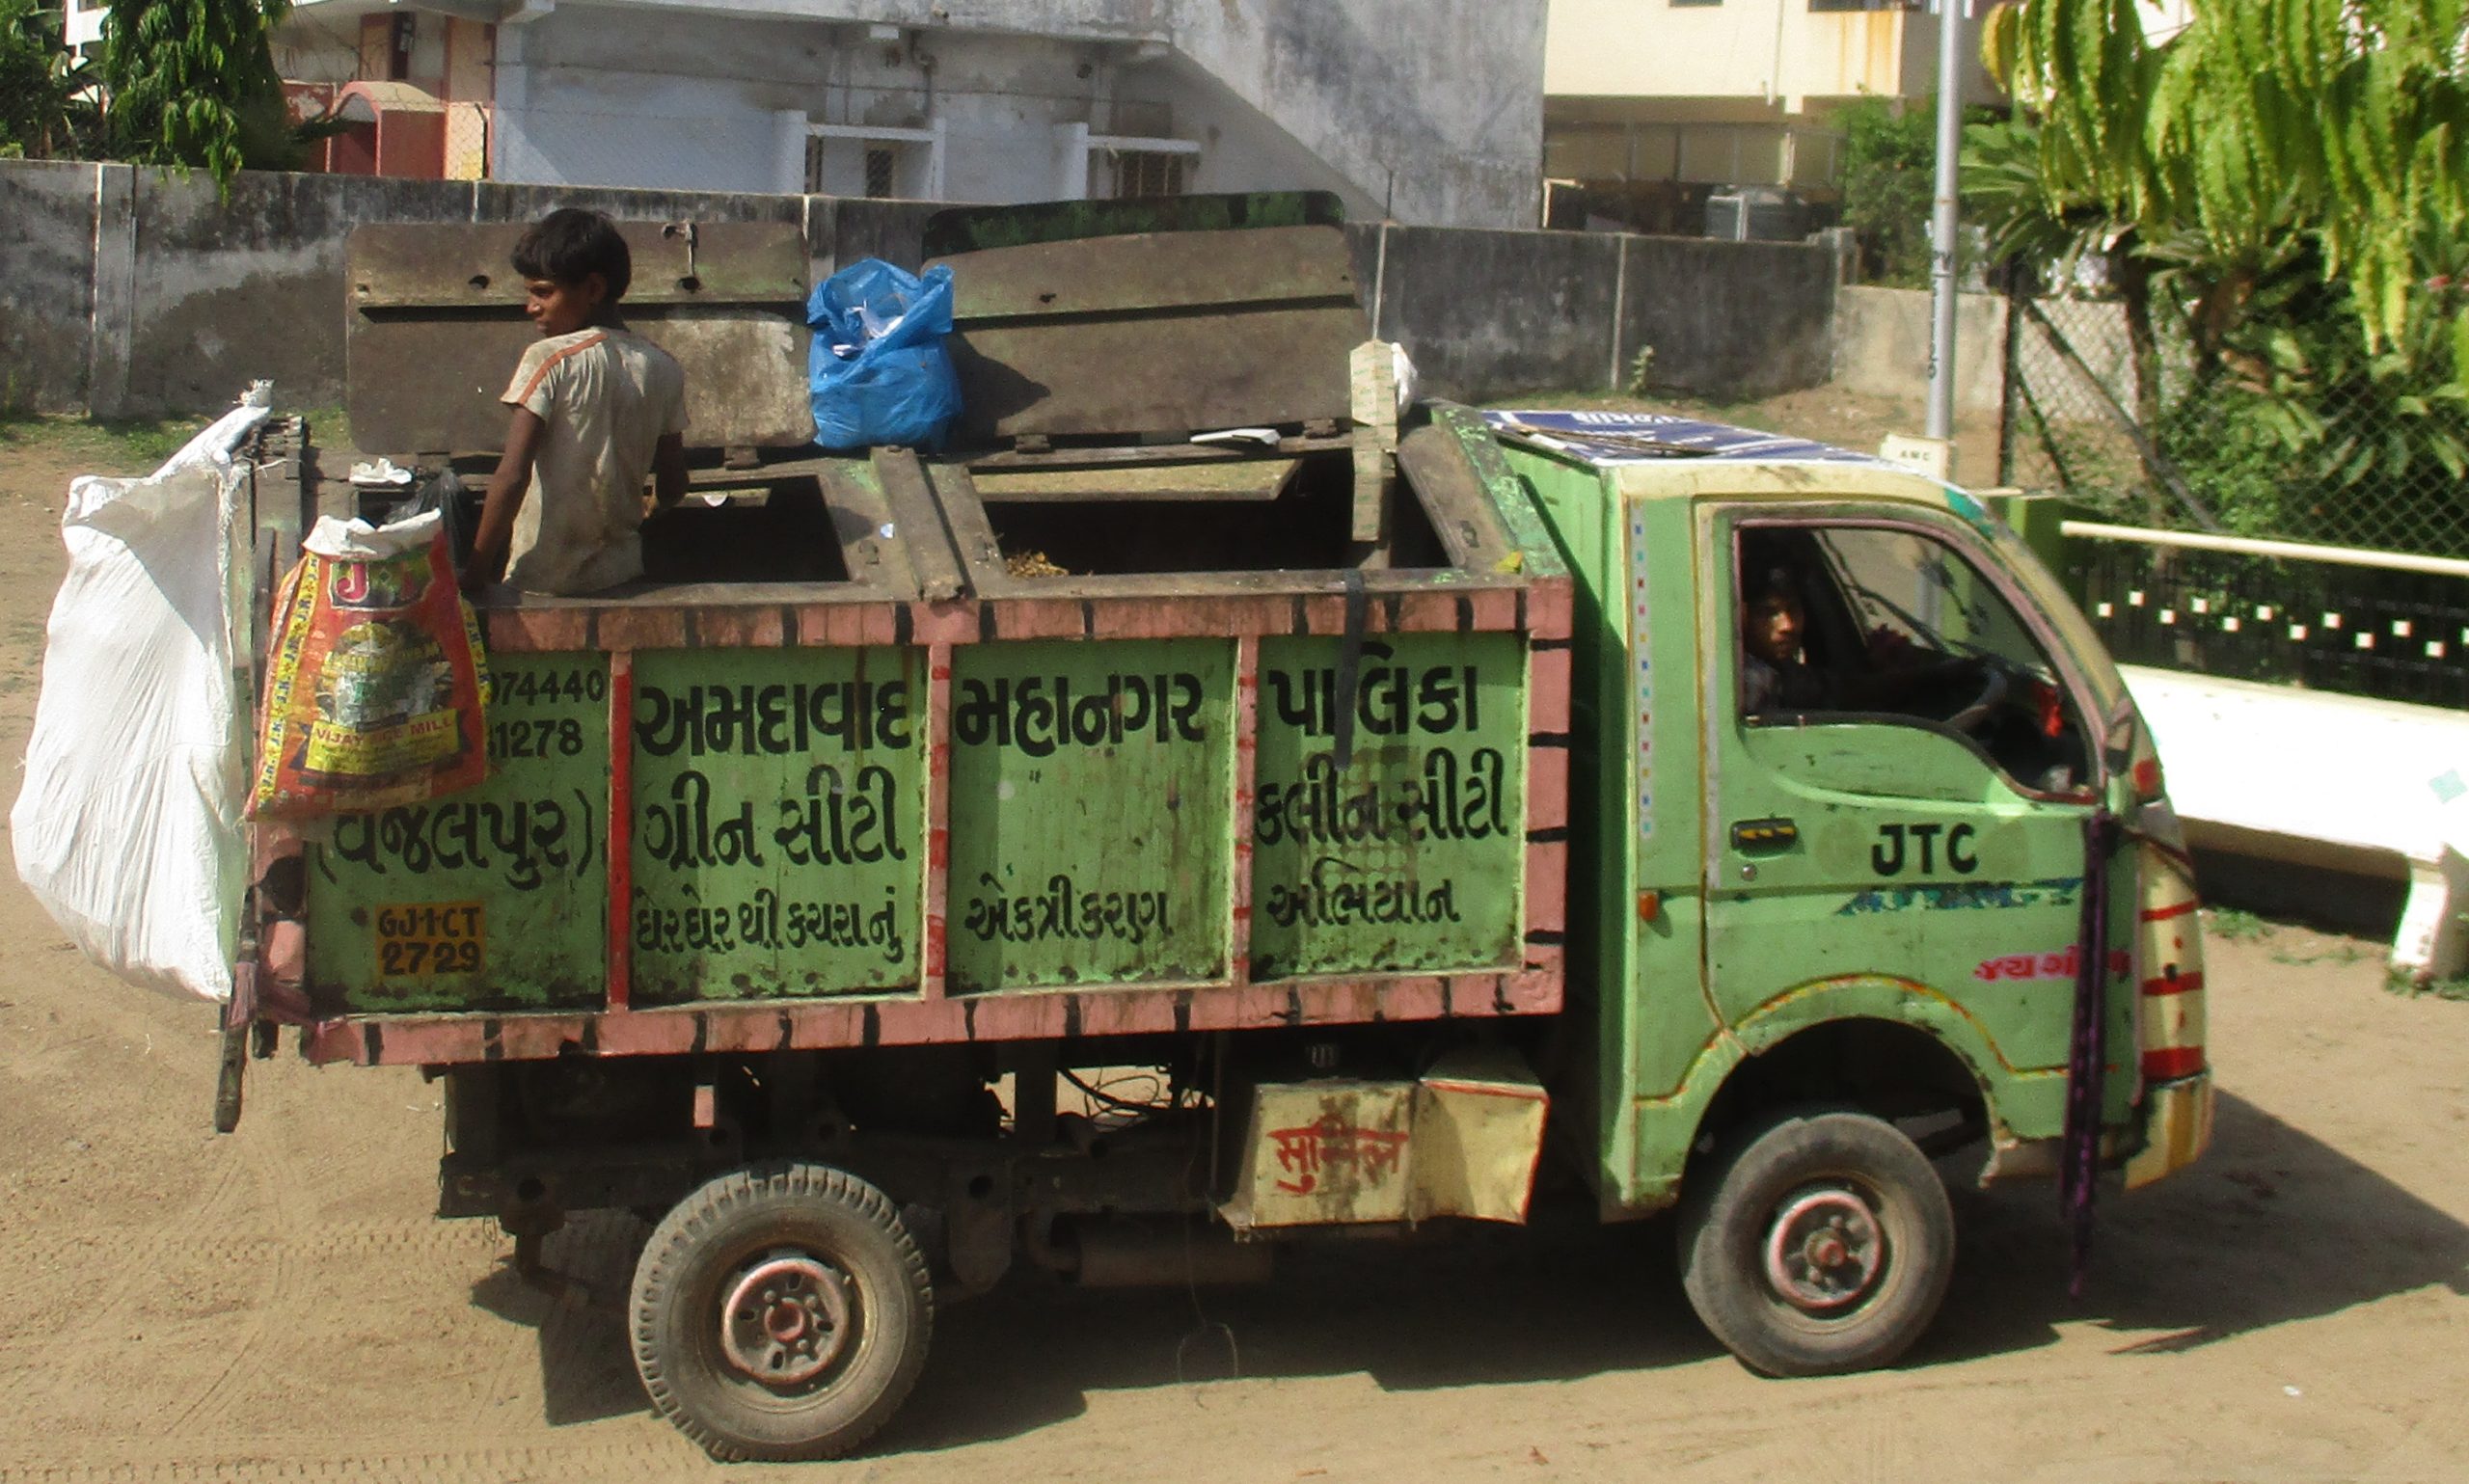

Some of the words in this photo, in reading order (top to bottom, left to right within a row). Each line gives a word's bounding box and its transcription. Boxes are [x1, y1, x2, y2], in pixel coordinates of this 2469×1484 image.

[316, 727, 364, 745] VIJAY
[410, 716, 452, 736] MILL
[634, 681, 911, 756] અમદાવાદ
[955, 672, 1206, 757] મહાનગર
[643, 770, 765, 871] ગ્રીન
[774, 764, 907, 866] સીટી
[1397, 747, 1508, 841] સીટી
[1872, 823, 1979, 877] JTC
[1265, 856, 1462, 929] અભિયાન
[382, 940, 480, 976] 2729
